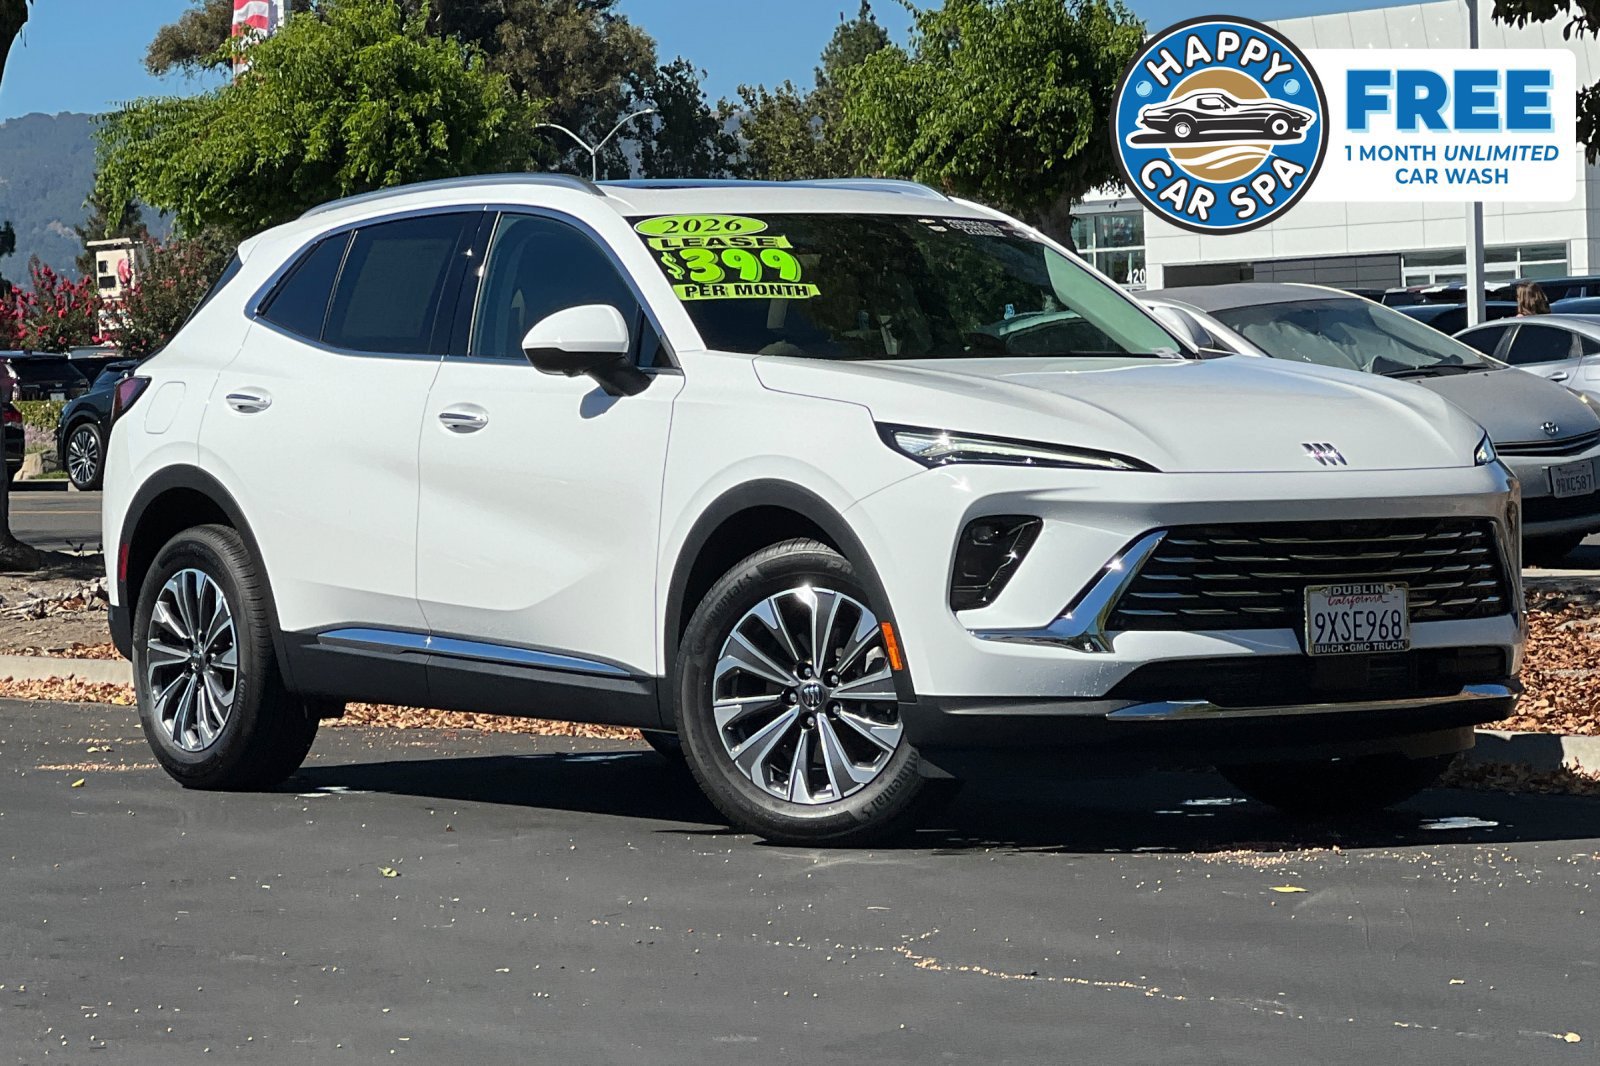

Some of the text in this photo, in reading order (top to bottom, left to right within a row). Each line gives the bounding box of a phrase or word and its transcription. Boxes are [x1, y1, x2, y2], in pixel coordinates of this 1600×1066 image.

[662, 218, 742, 234] 2026
[660, 237, 778, 249] LEASE
[684, 283, 811, 298] PER MONTH
[1332, 584, 1385, 595] DUBLIN
[1314, 609, 1402, 643] 9XSE968
[1315, 641, 1405, 653] BUICK GMC TRUCK
